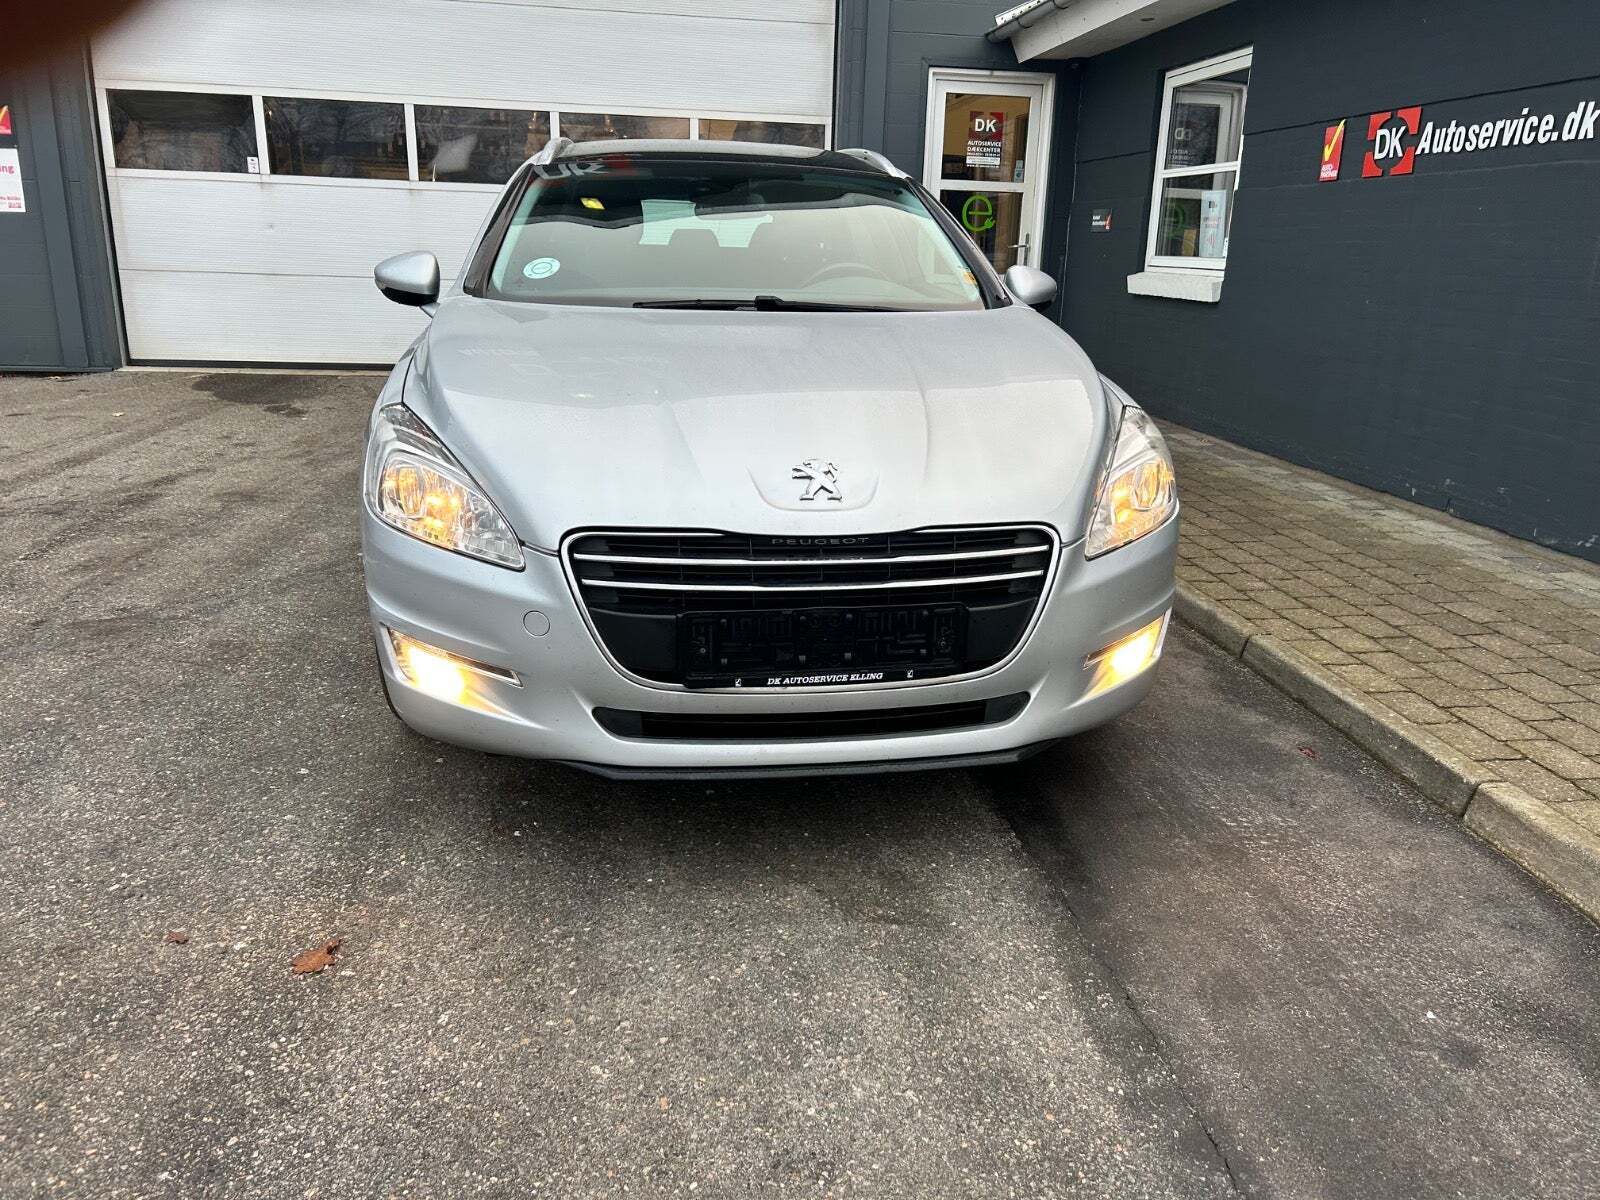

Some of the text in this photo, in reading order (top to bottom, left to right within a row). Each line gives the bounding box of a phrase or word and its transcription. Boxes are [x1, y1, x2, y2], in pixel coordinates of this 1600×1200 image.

[974, 118, 996, 133] DK
[1374, 101, 1600, 160] DK Autoservice.dk
[772, 537, 869, 545] PEUGEOT
[767, 678, 781, 686] DK
[783, 673, 849, 685] AUTOSERVICE
